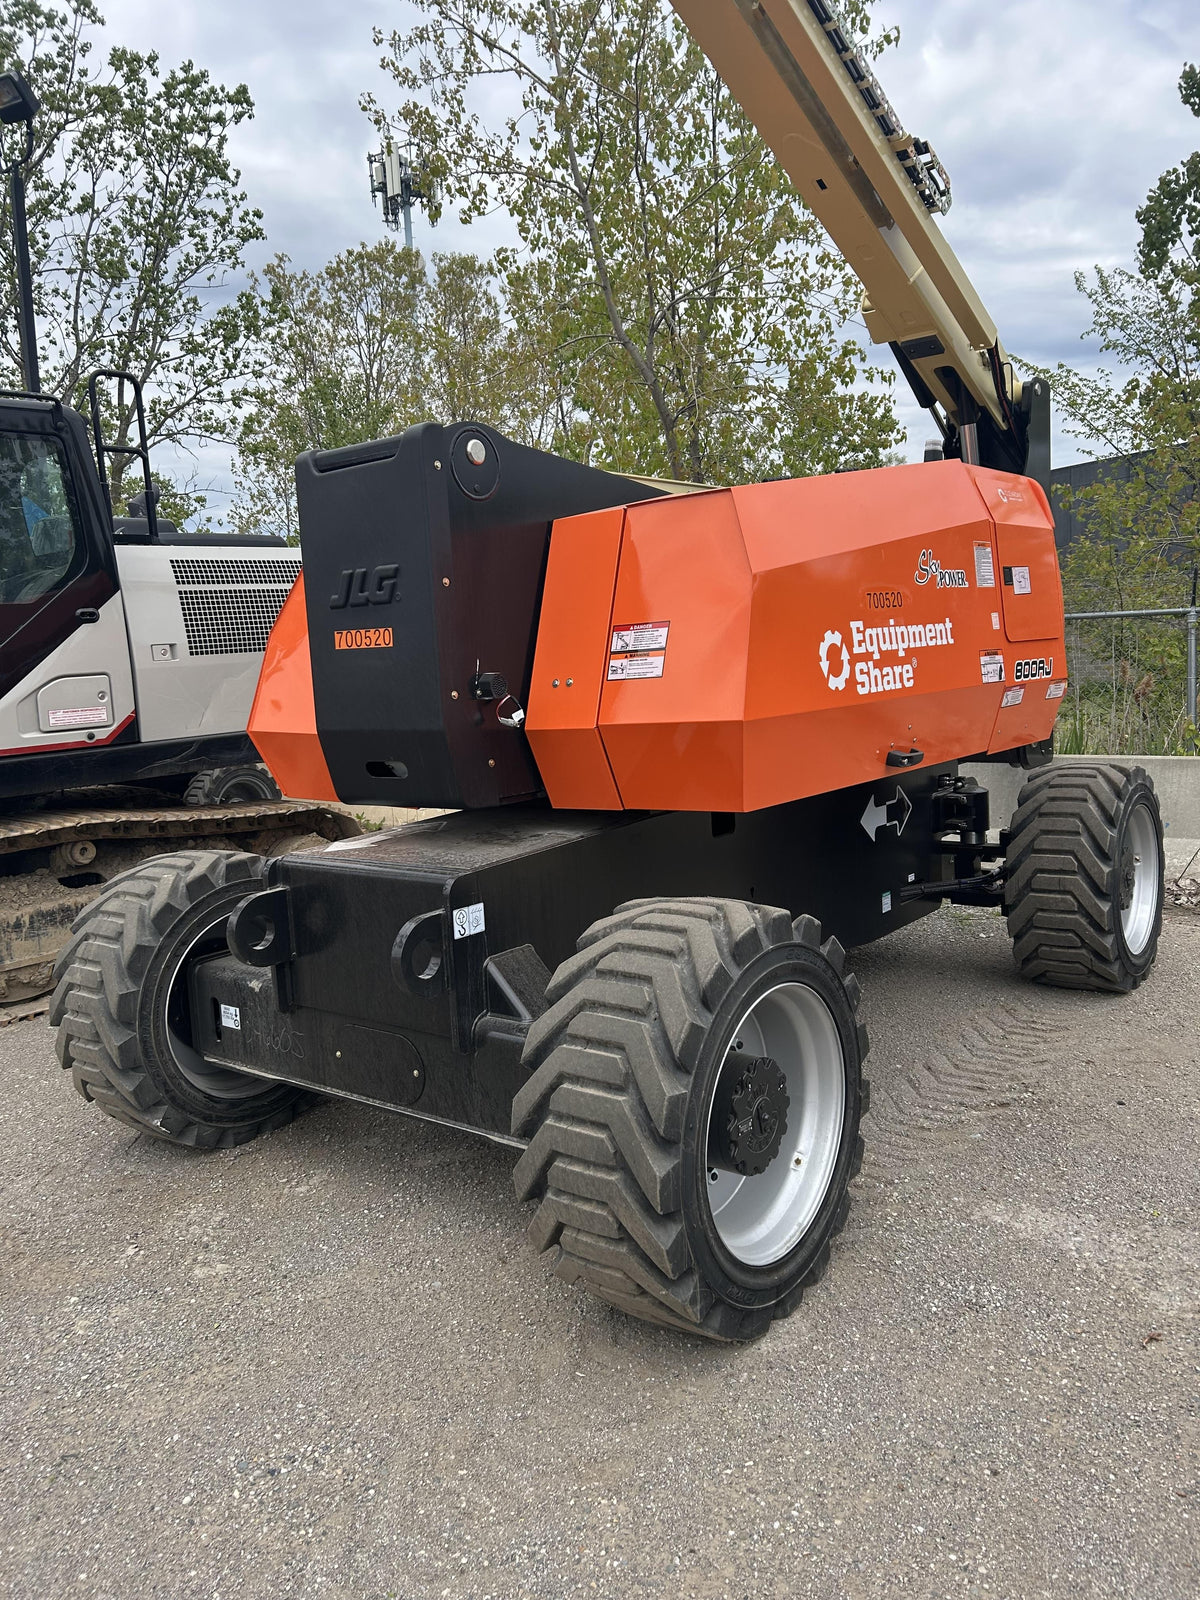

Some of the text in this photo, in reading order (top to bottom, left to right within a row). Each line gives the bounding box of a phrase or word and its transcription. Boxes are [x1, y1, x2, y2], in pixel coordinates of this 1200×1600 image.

[915, 550, 940, 588] Sky
[938, 569, 968, 588] POWER
[329, 564, 399, 610] JLG
[866, 591, 903, 609] 700520
[336, 628, 392, 648] 700520
[849, 617, 954, 660] Equipment
[1014, 657, 1053, 681] 800AJ
